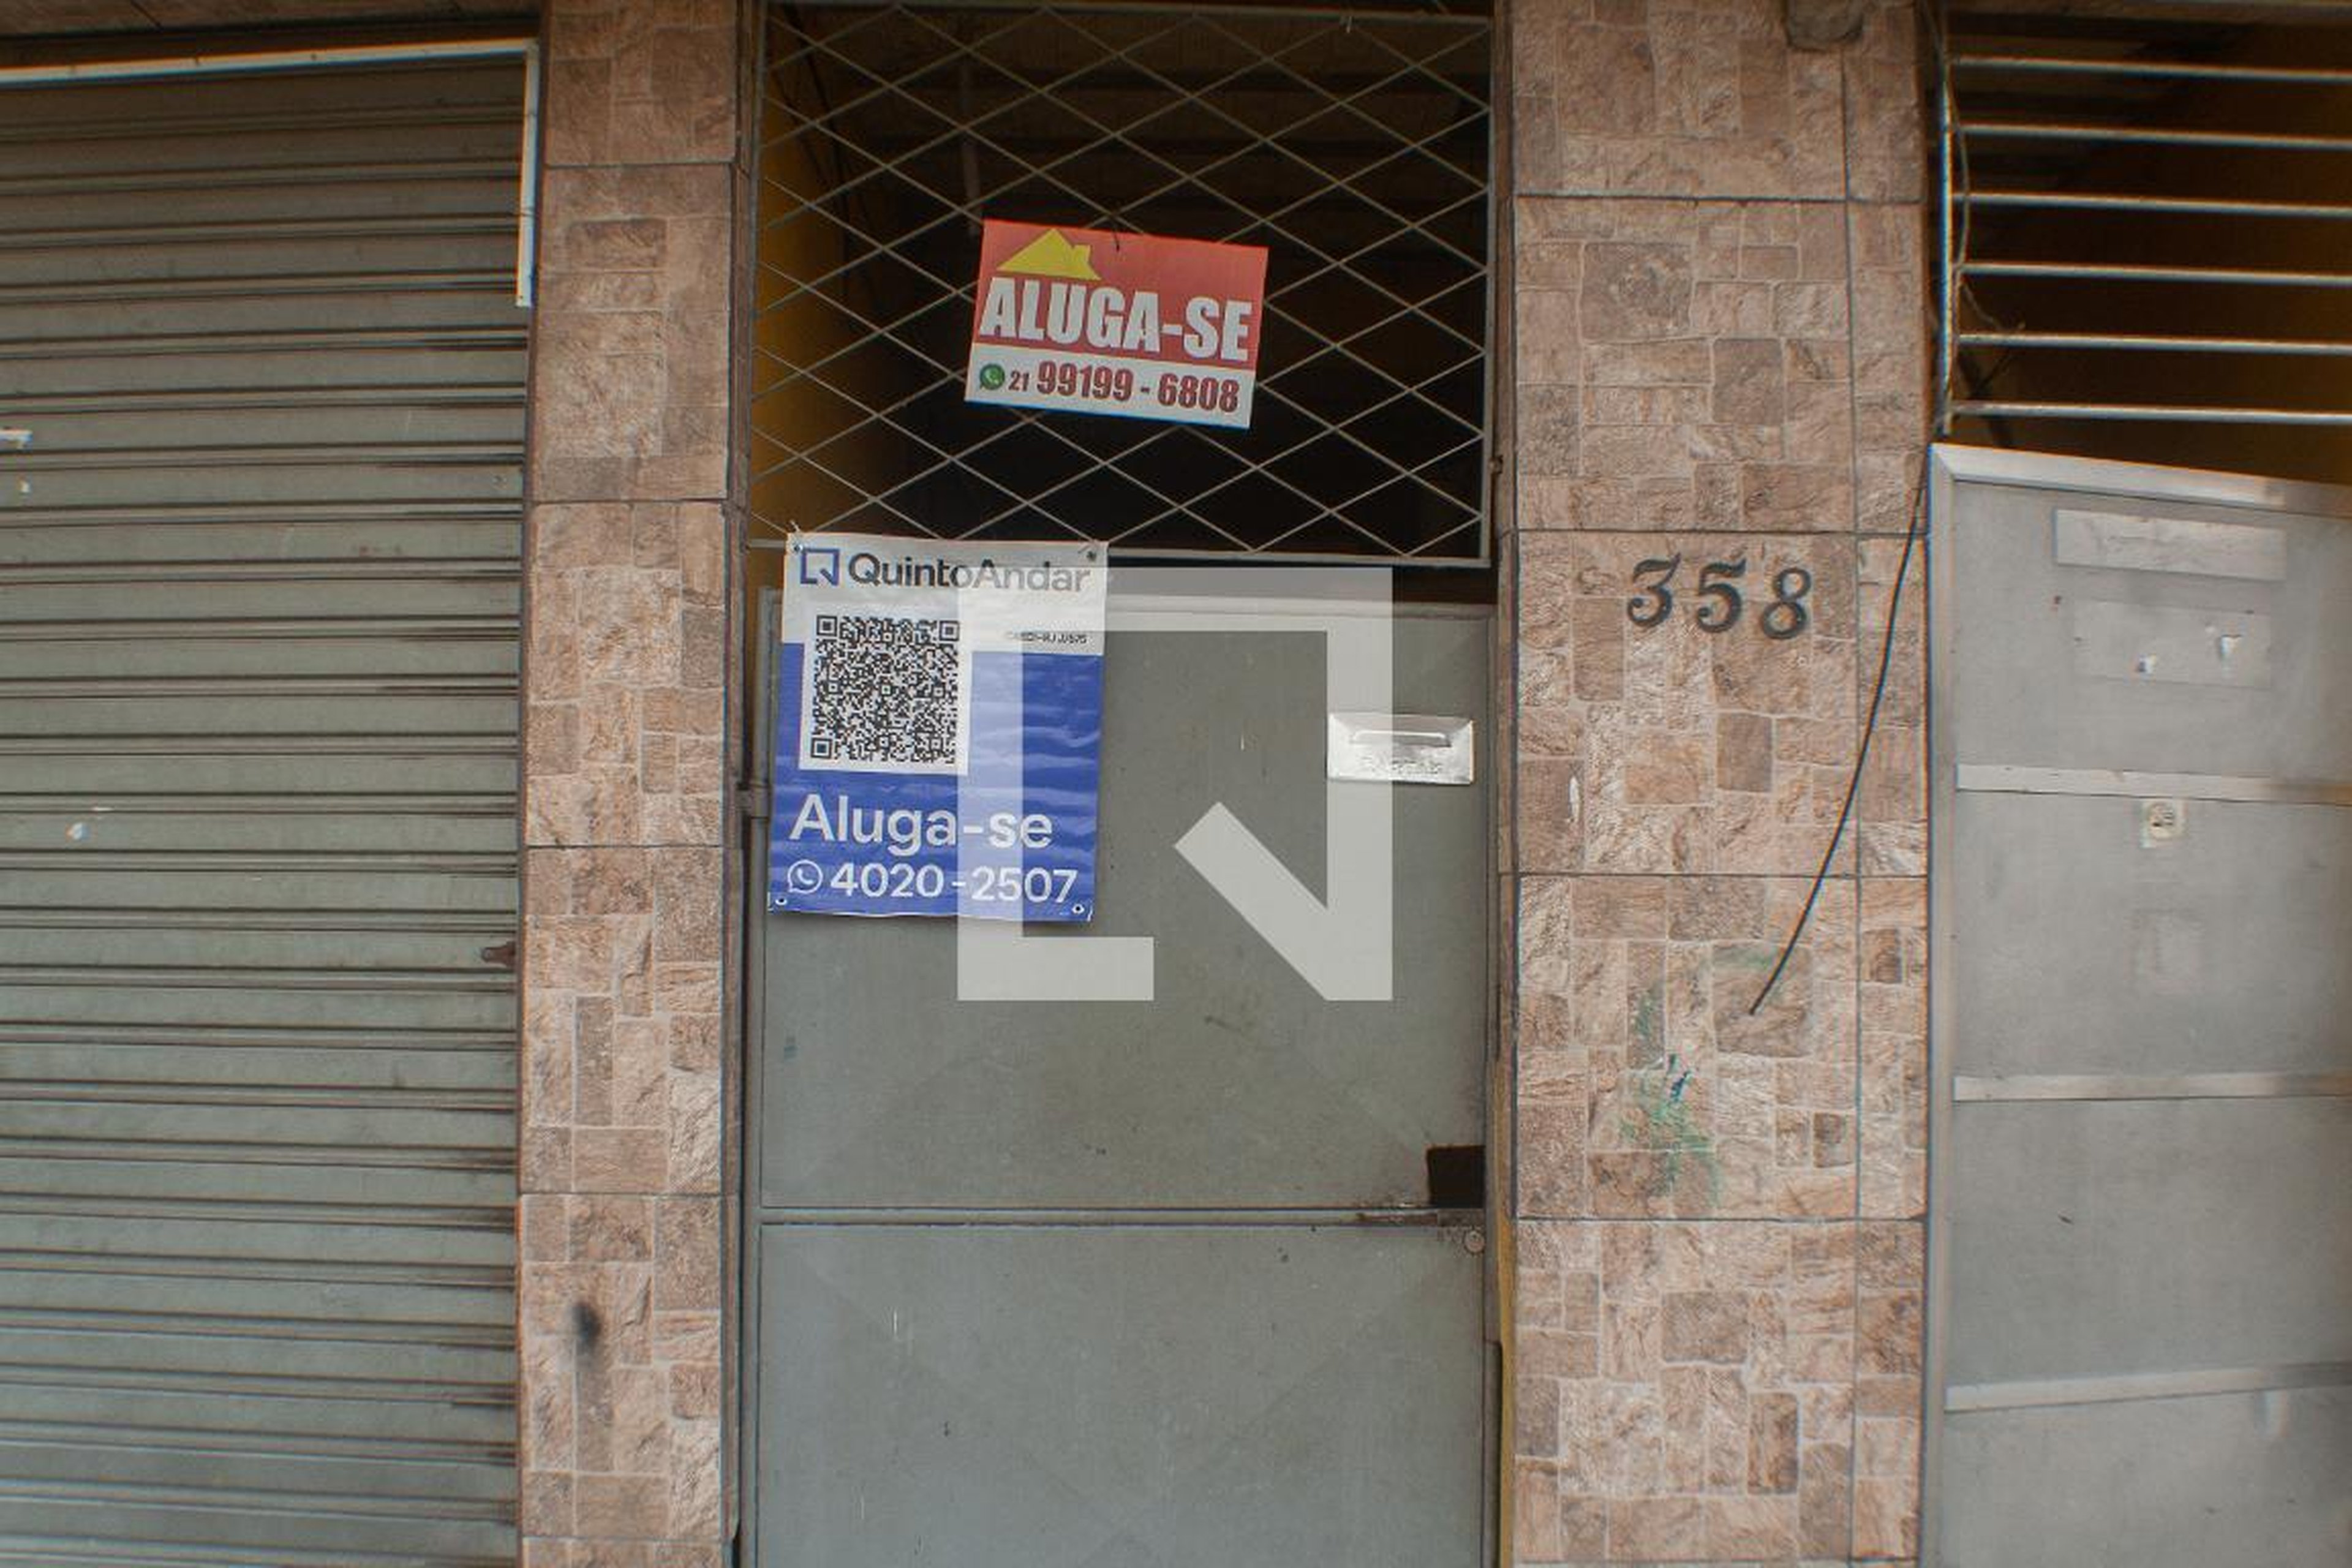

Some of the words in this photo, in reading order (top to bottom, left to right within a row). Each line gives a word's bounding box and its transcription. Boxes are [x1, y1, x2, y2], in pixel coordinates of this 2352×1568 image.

[979, 277, 1251, 361] ALUGA-SE
[1008, 370, 1030, 392] 21
[1036, 360, 1133, 401] 99199
[1158, 374, 1240, 413] 6808
[848, 552, 1091, 593] QuintoAndar
[1627, 552, 1812, 640] 358
[789, 793, 1054, 856] Aluga-se
